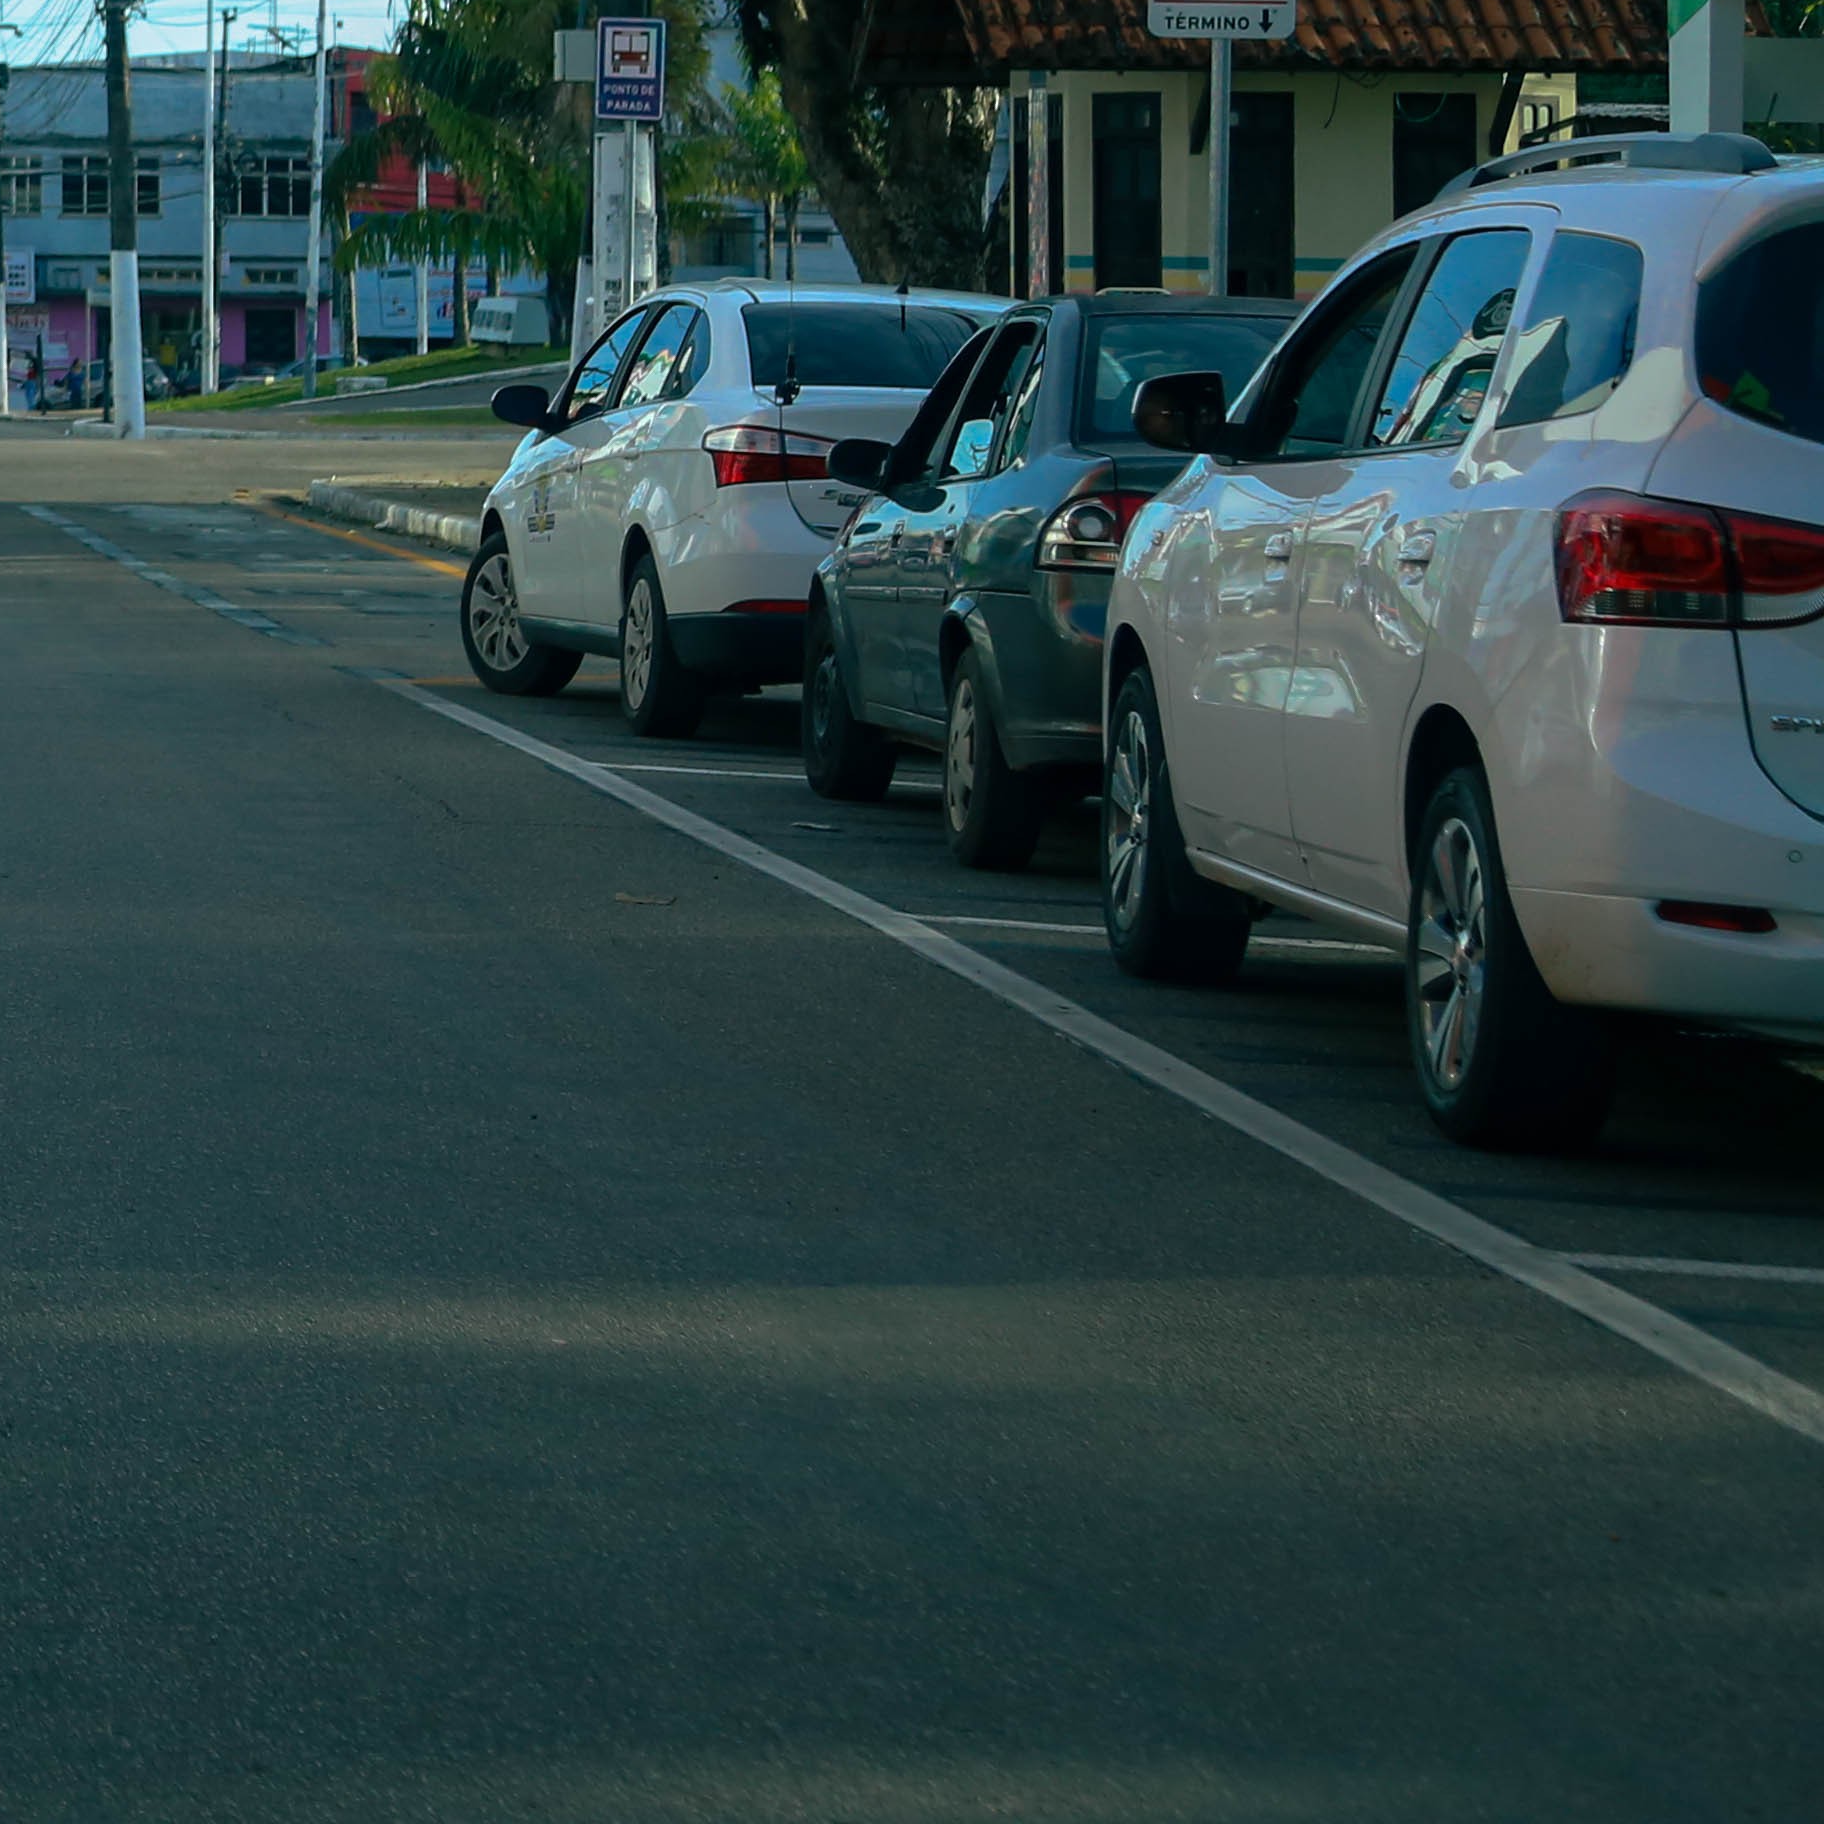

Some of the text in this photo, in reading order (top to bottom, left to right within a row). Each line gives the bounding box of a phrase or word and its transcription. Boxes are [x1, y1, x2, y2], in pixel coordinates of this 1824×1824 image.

[1165, 11, 1250, 31] TÉRMINO
[603, 83, 655, 96] PONTO DE
[606, 99, 651, 112] PARADA
